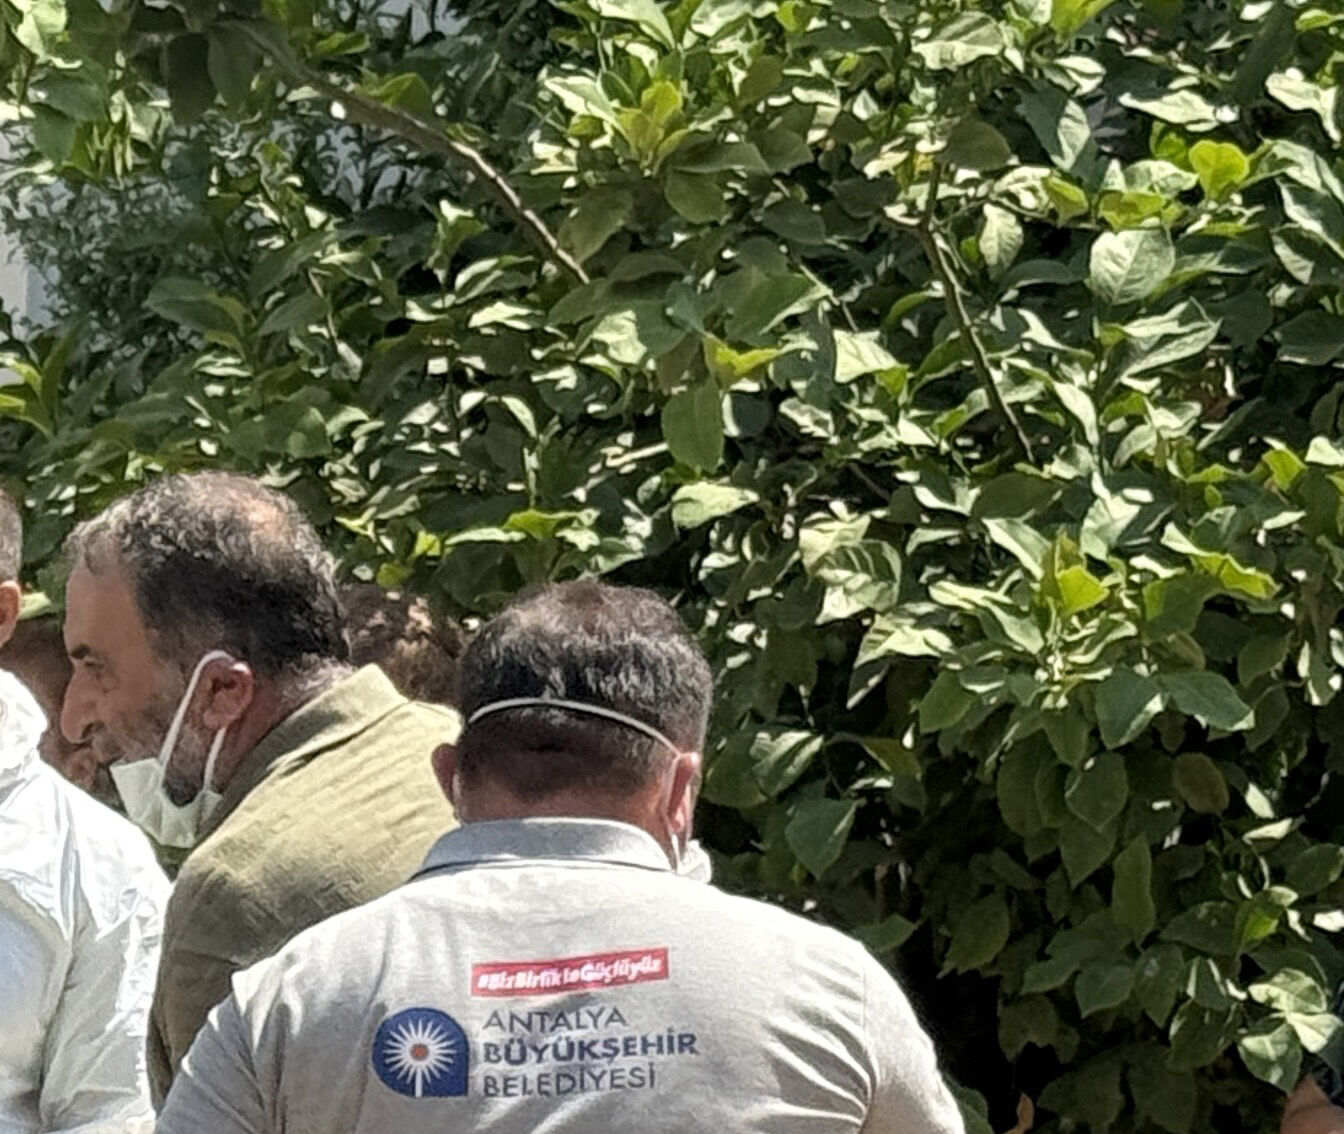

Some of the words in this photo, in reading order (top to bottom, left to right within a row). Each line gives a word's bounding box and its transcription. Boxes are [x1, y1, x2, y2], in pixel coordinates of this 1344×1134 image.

[483, 1006, 626, 1032] ANTALYA
[484, 1028, 699, 1066] BÜYÜKŞEHİR
[483, 1063, 656, 1098] BELEDİYESİ
